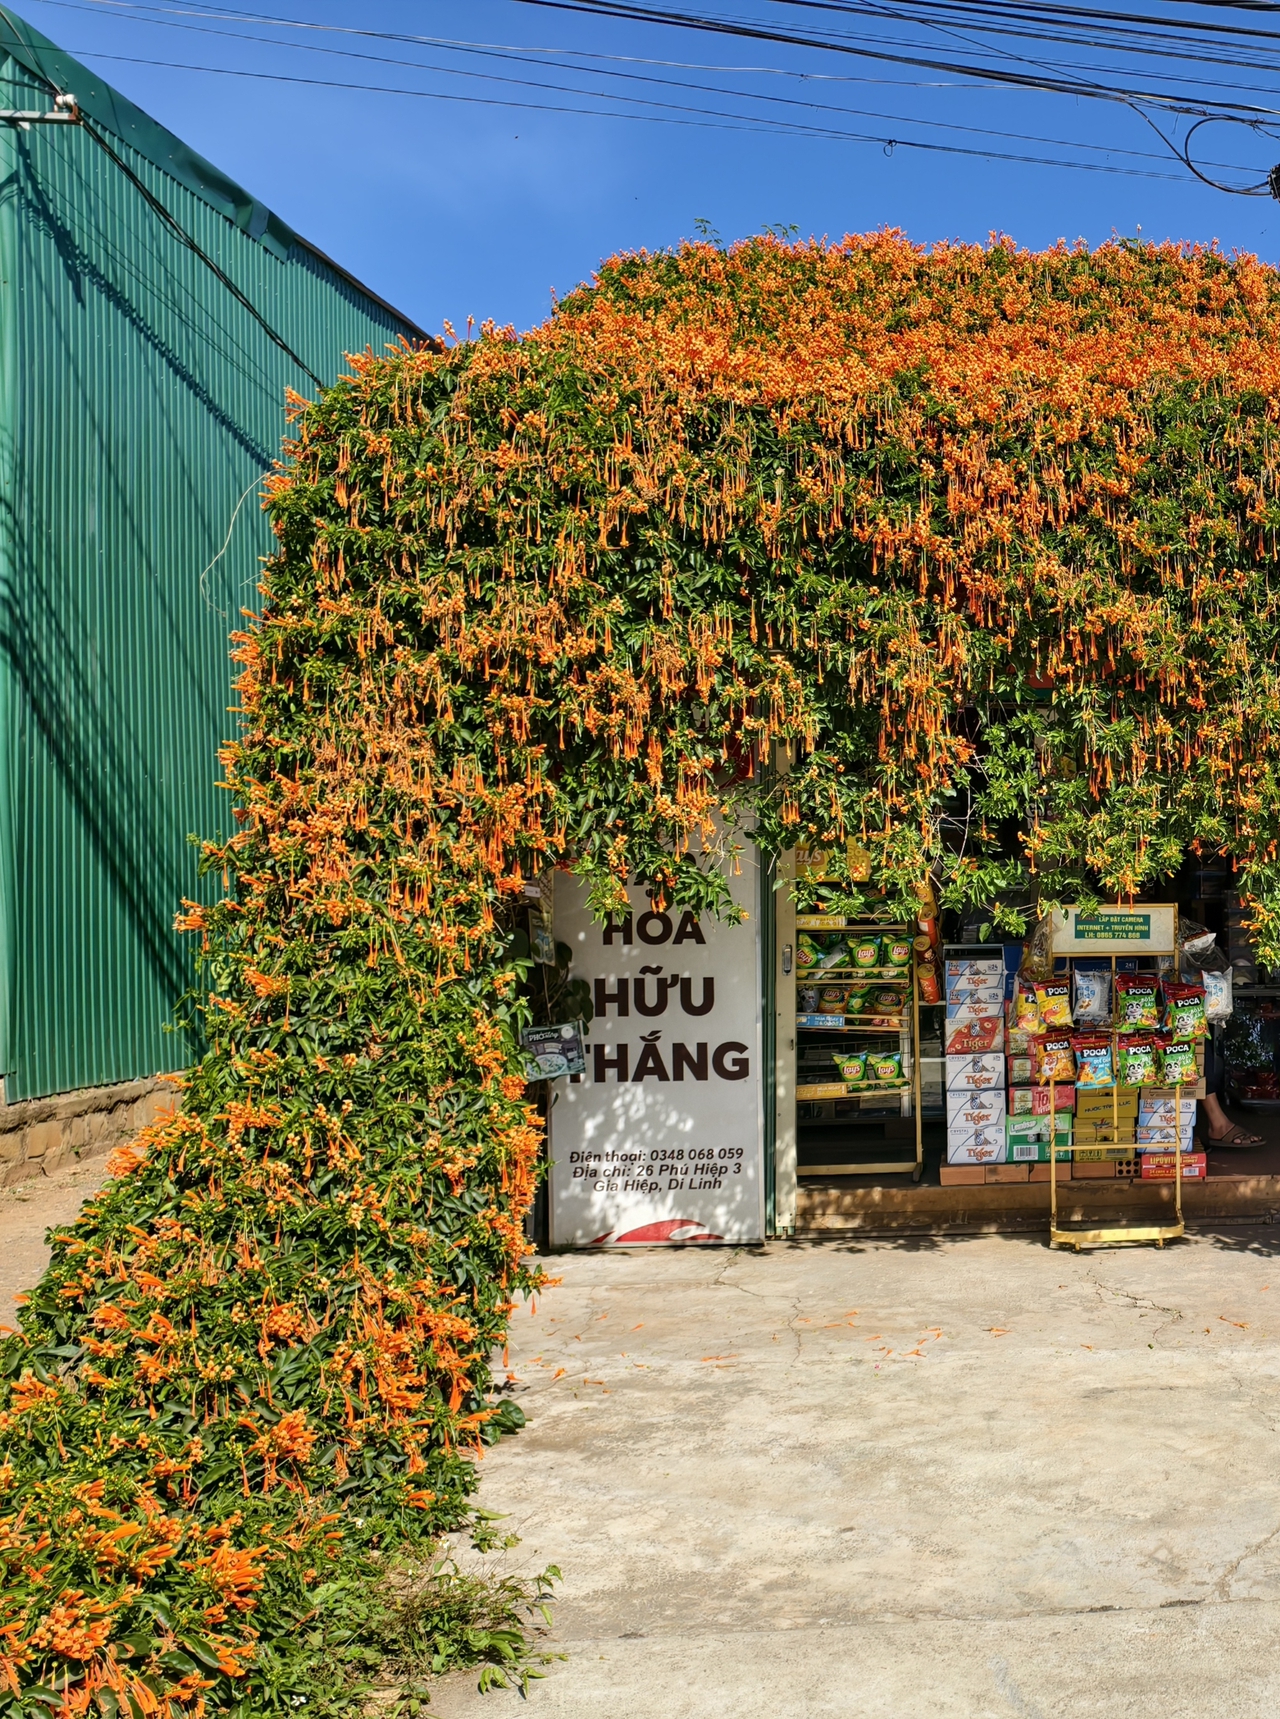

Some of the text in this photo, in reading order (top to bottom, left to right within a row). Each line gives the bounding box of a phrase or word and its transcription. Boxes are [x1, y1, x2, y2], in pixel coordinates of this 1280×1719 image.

[966, 976, 988, 987] Tiger
[594, 965, 715, 1017] HỮU
[1046, 986, 1069, 996] POCA
[1176, 997, 1200, 1008] POCA
[967, 1005, 989, 1016] Tiger
[961, 1037, 990, 1051] Tiger
[1045, 1041, 1070, 1051] POCA
[1128, 1045, 1152, 1055] POCA
[1165, 1044, 1189, 1054] POCA
[569, 1030, 750, 1083] HẮNG
[1082, 1048, 1107, 1057] POCA
[965, 1074, 993, 1089] Tiger
[963, 1111, 991, 1126] Tiger
[605, 1150, 646, 1165] thoại:
[650, 1148, 684, 1161] 0348
[688, 1147, 714, 1160] 068
[718, 1147, 743, 1160] 059
[966, 1147, 994, 1162] Tiger
[572, 1165, 598, 1181] Địa
[636, 1164, 654, 1177] 26
[658, 1163, 690, 1176] Phú
[693, 1162, 728, 1178] Hiệp
[732, 1162, 742, 1174] 3
[593, 1177, 722, 1194] Gia Hiệp, Di Linh
